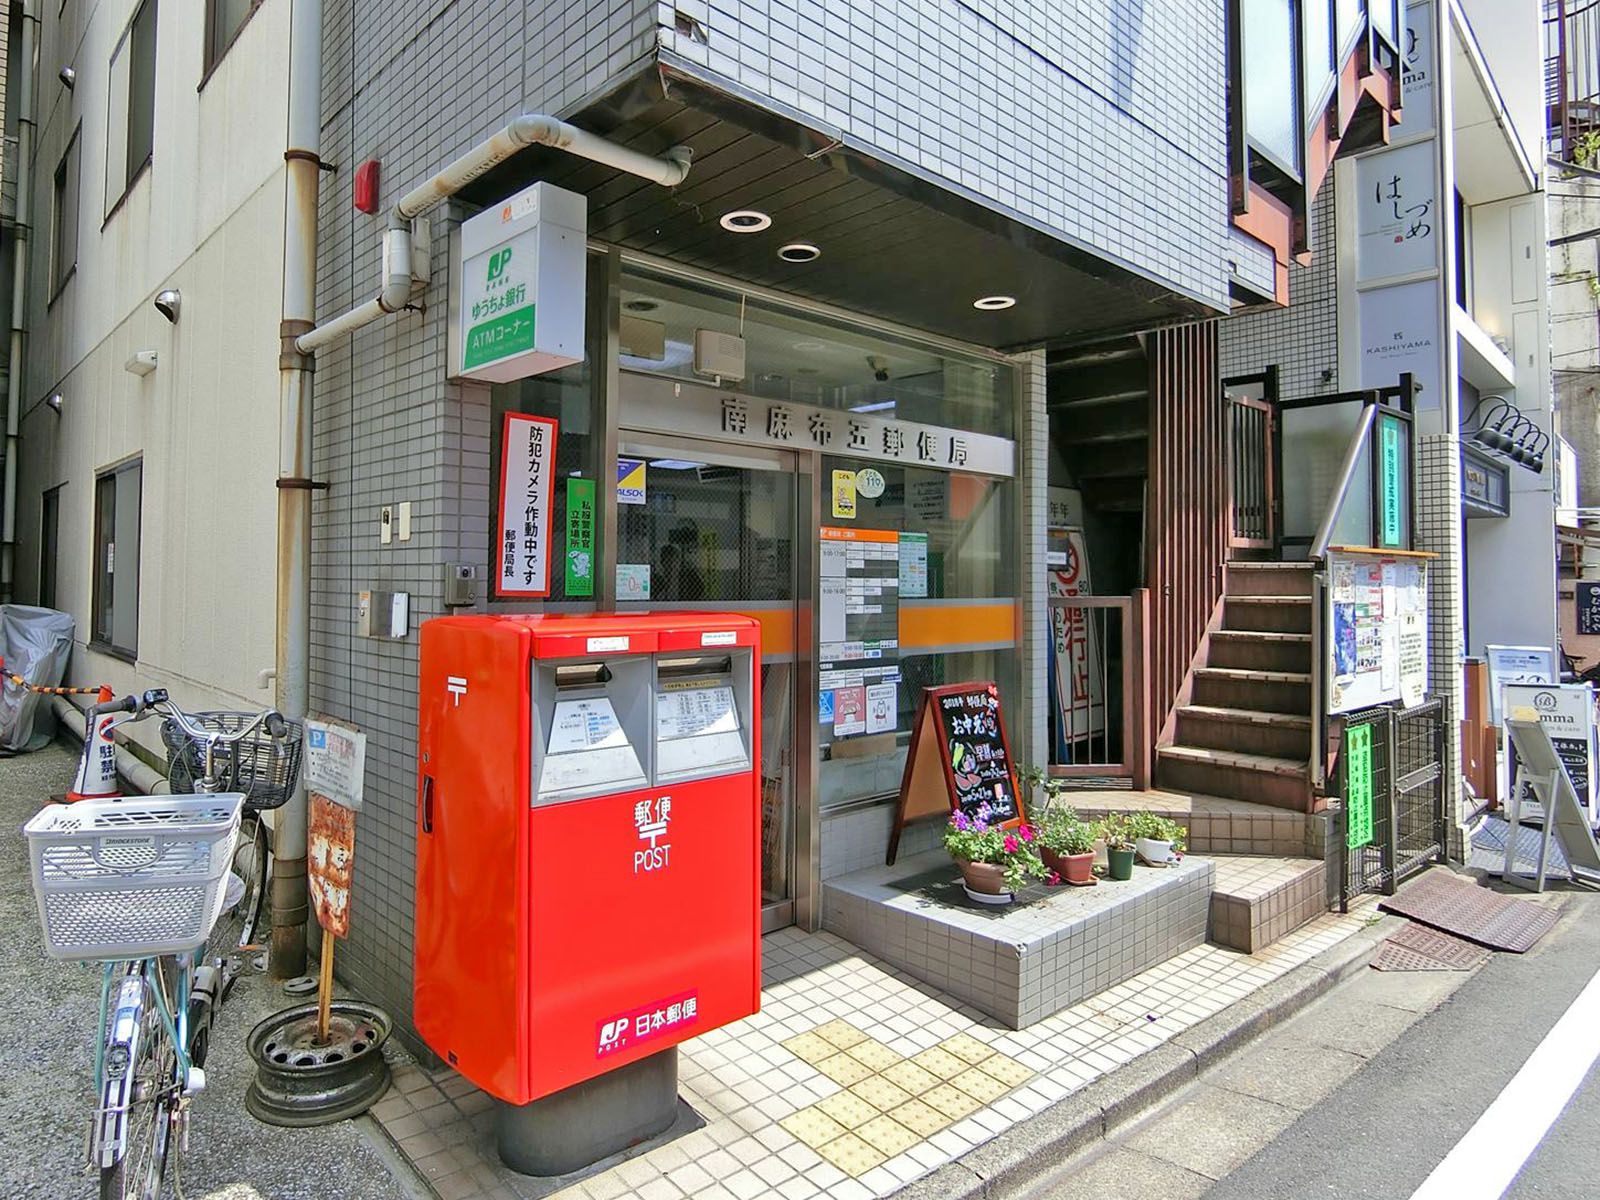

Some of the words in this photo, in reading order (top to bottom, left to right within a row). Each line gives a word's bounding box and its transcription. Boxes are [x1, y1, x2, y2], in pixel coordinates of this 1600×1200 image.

[472, 283, 526, 320] ゆうちょ銀行
[472, 318, 531, 348] ATMコーナー
[1366, 340, 1431, 354] KASHIYAMA
[721, 399, 967, 466] 南麻布五郵便局
[522, 426, 543, 586] 防犯カメラ作動中です
[504, 529, 516, 577] 郵便局長
[312, 731, 321, 745] P
[634, 796, 671, 826] 郵便
[633, 845, 671, 873] POST
[636, 997, 697, 1038] 日本郵便
[598, 1038, 626, 1054] POST
